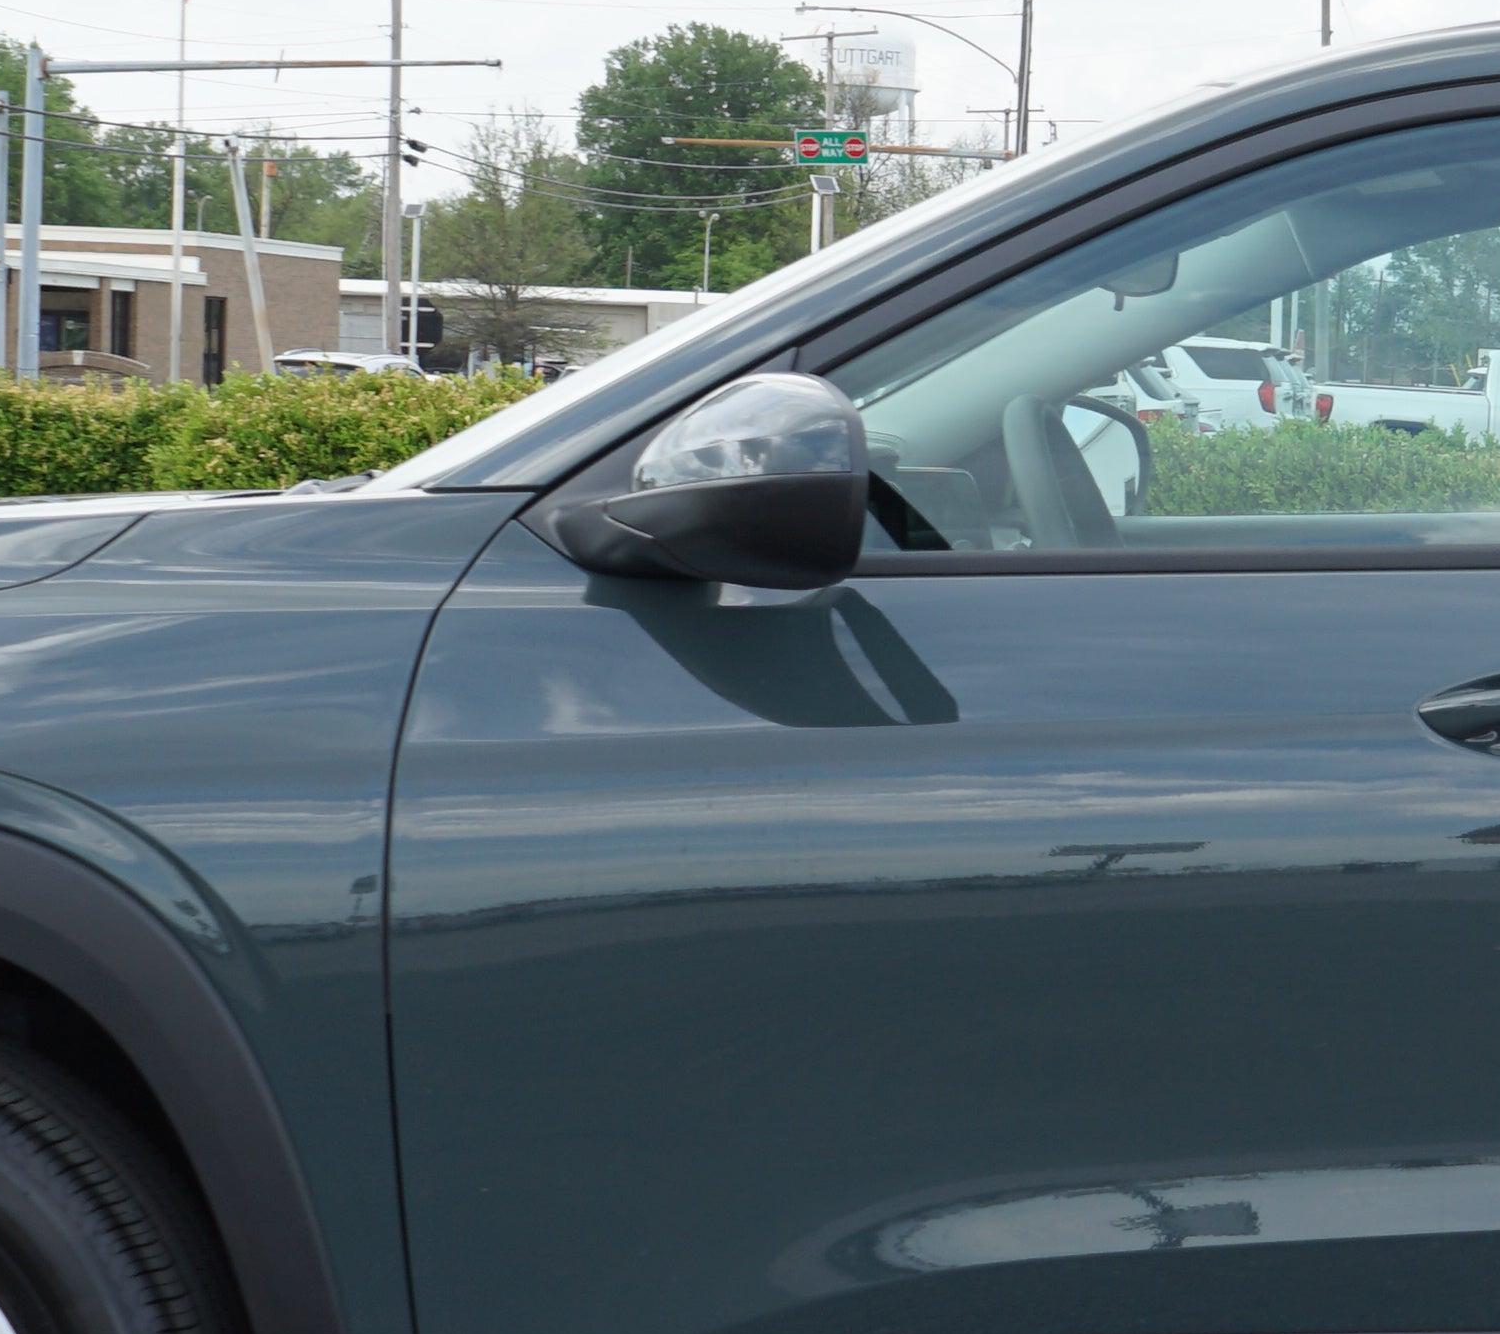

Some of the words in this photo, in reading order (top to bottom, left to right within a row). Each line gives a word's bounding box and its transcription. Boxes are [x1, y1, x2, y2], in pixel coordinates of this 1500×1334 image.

[820, 47, 901, 66] SUTTGART
[822, 137, 842, 147] ALL
[822, 148, 843, 158] WAY
